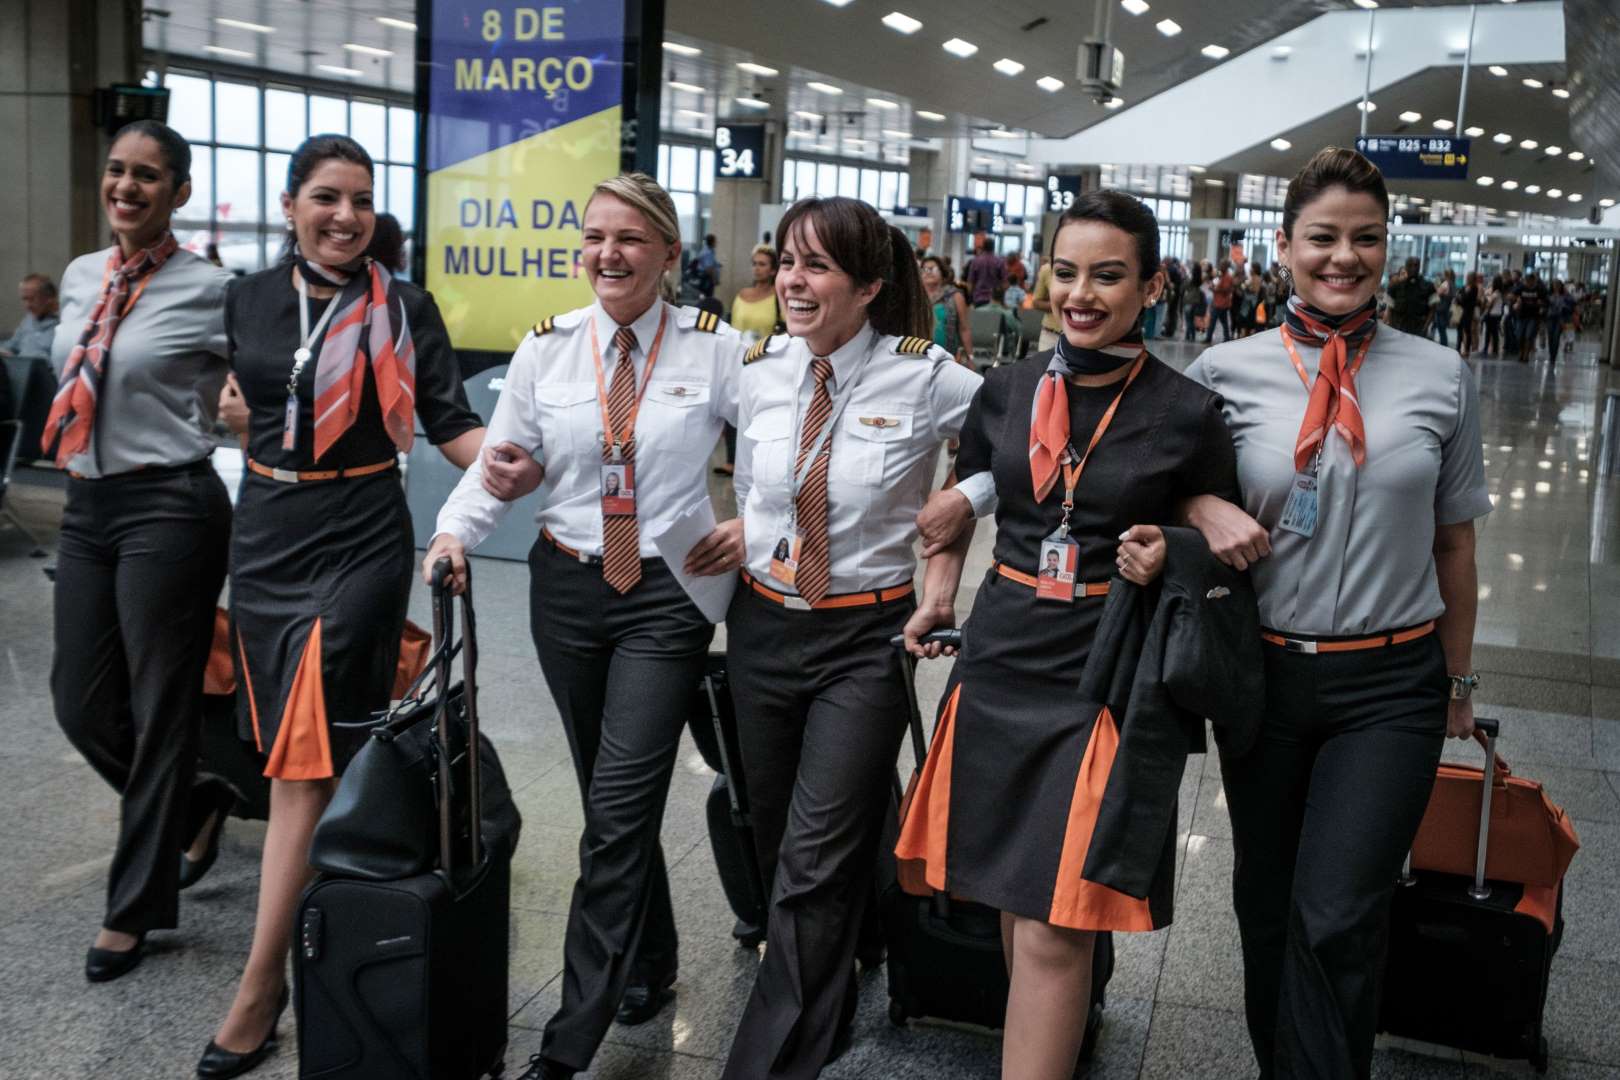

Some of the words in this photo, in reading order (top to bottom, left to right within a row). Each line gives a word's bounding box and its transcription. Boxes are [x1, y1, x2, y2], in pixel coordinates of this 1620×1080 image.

[482, 9, 502, 42] 8
[515, 7, 565, 41] DE
[455, 56, 593, 100] MARÇO
[716, 127, 731, 148] B
[720, 148, 755, 176] 34
[460, 199, 518, 229] DIA
[532, 199, 583, 230] DA
[1050, 191, 1075, 211] 33
